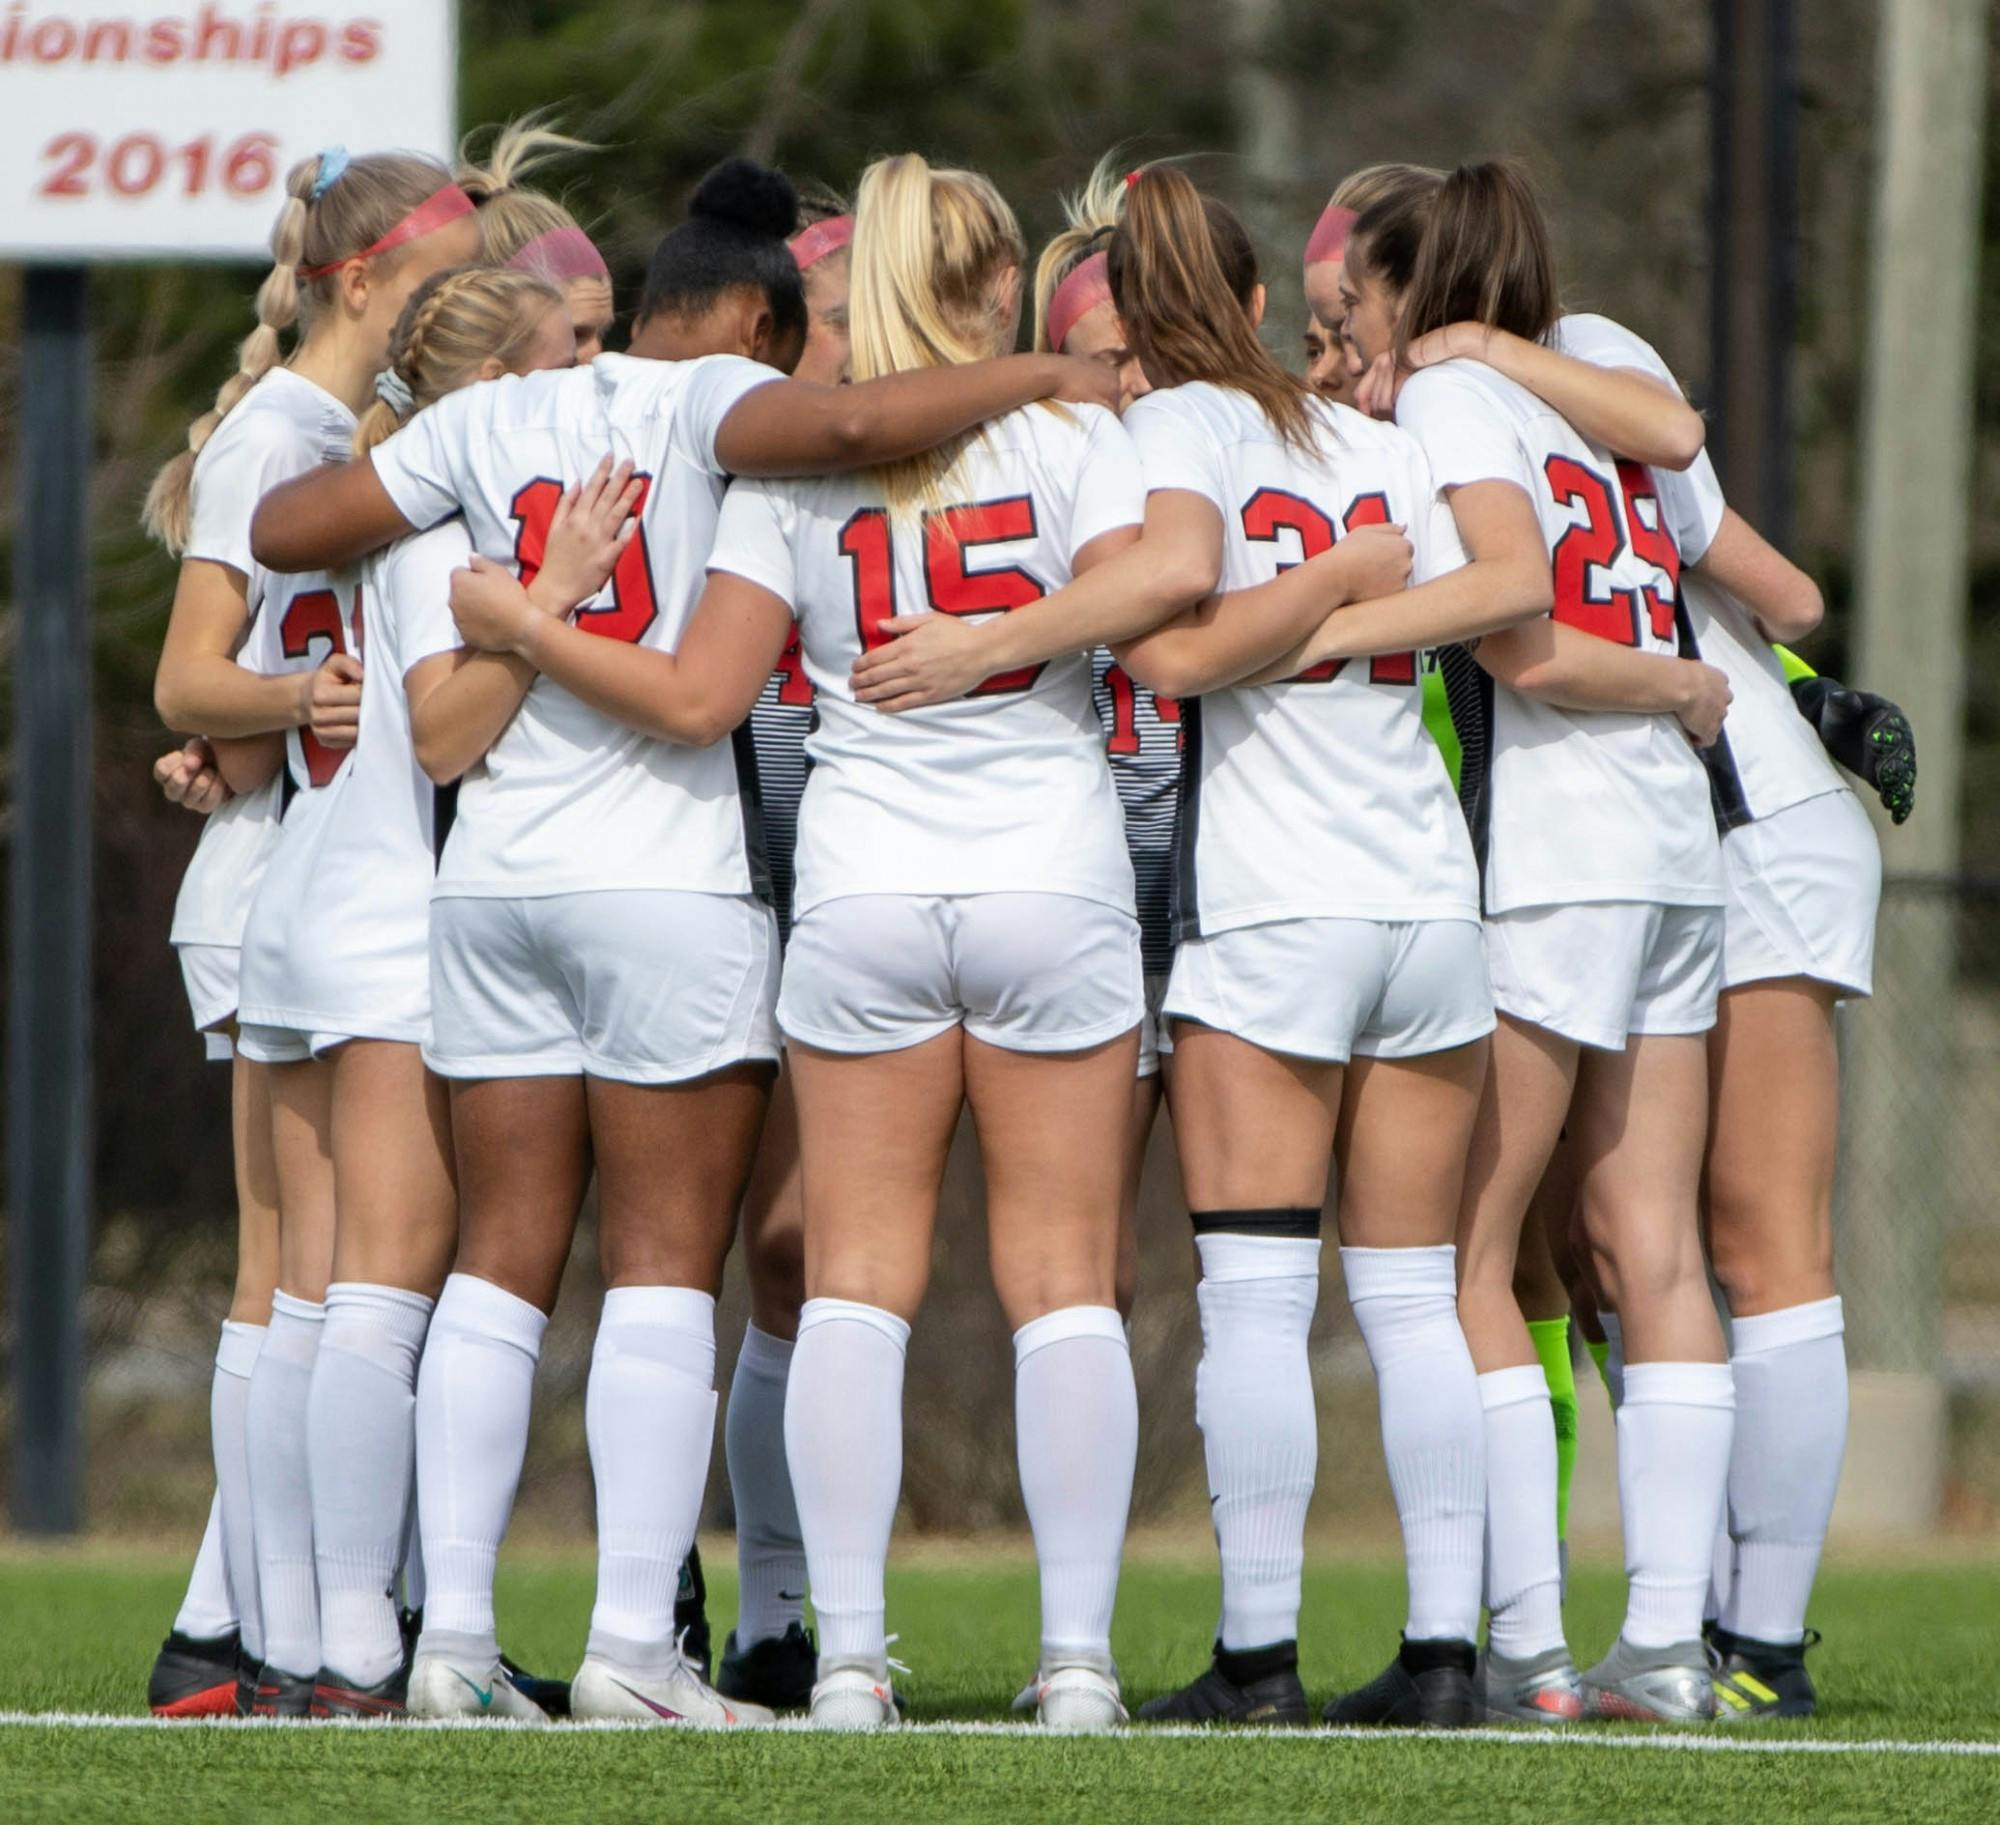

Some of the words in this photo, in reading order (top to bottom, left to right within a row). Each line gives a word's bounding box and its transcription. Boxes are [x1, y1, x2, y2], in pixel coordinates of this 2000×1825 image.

[0, 3, 383, 77] ionships
[38, 130, 281, 197] 2016
[837, 493, 1049, 698] 15
